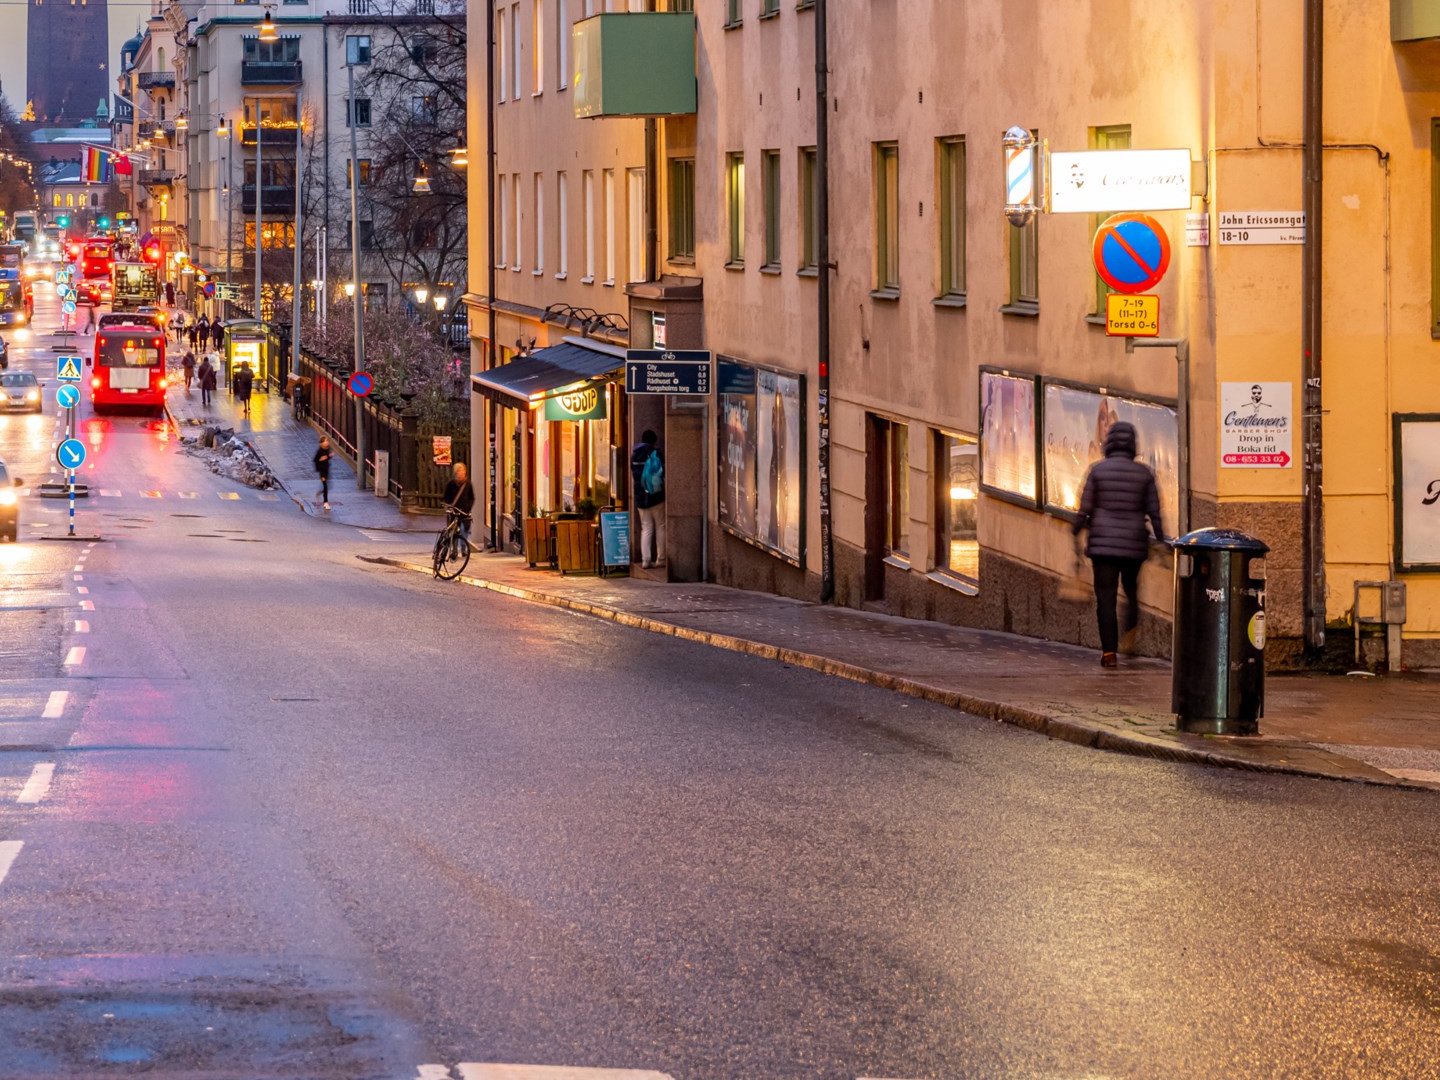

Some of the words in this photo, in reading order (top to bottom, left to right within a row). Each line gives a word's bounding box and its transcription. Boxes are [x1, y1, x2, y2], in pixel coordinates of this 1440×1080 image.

[1222, 215, 1243, 225] John
[1222, 231, 1249, 241] 18-10
[1123, 299, 1144, 307] 7-19
[1119, 310, 1147, 319] (11-17)
[1109, 320, 1135, 329] Torsd
[1138, 321, 1157, 329] 0-6
[1224, 411, 1288, 428] Gentlemen's
[1239, 434, 1263, 443] Drop
[1265, 434, 1274, 442] in
[1237, 445, 1261, 453] Boka
[1264, 445, 1276, 453] tid
[1273, 455, 1285, 463] 02
